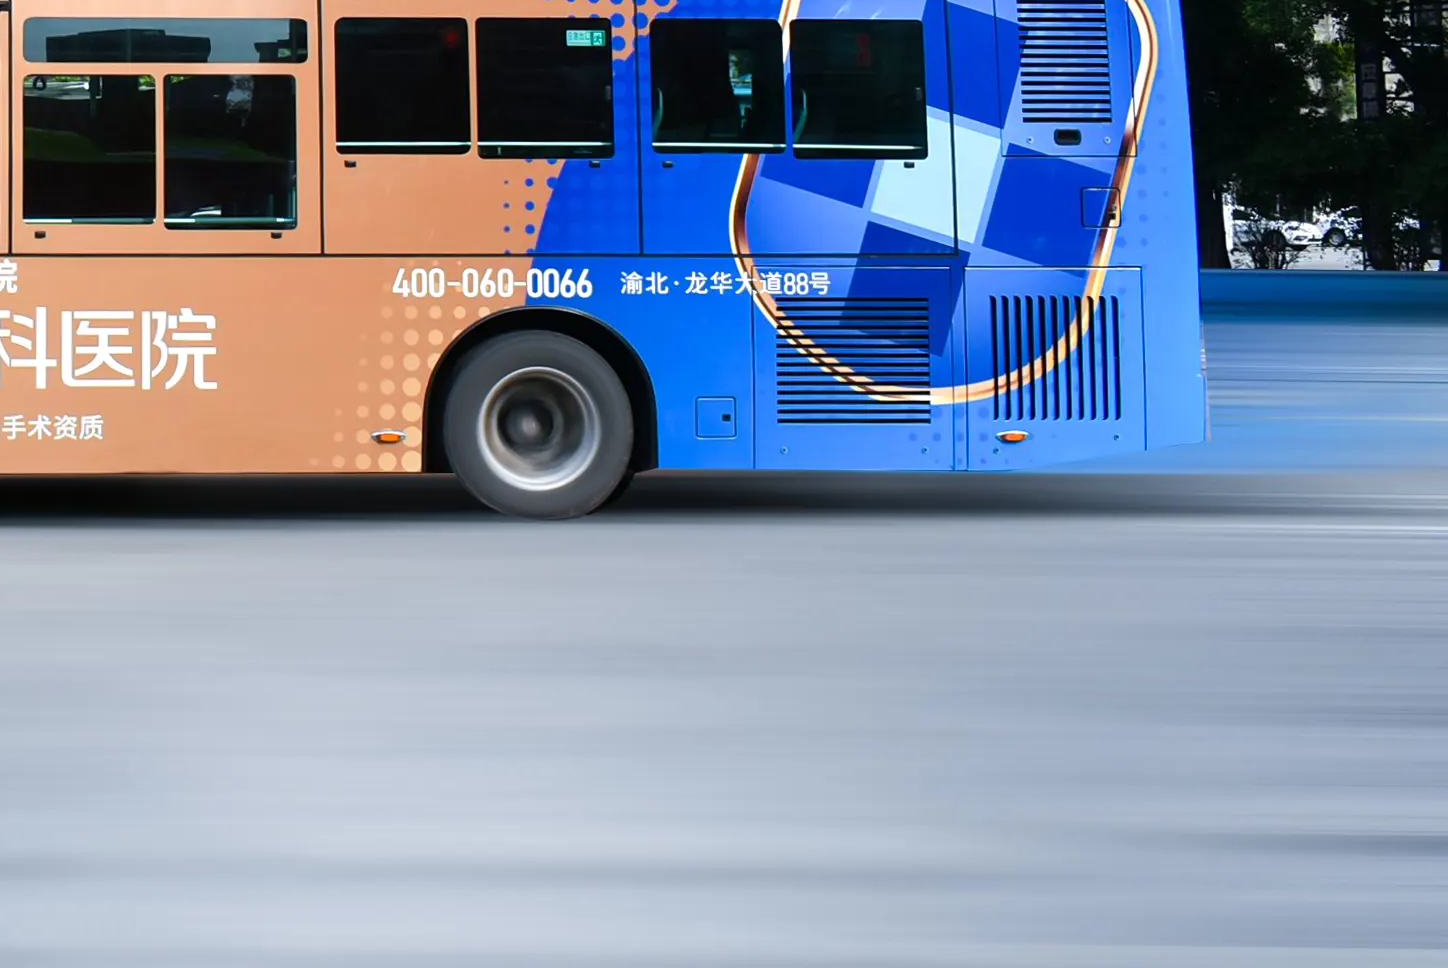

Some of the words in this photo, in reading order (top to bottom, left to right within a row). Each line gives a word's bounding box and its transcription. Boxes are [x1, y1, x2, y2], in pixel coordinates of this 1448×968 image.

[392, 268, 593, 298] 400-060-0066
[620, 271, 831, 296] 渝北·龙华大道88号
